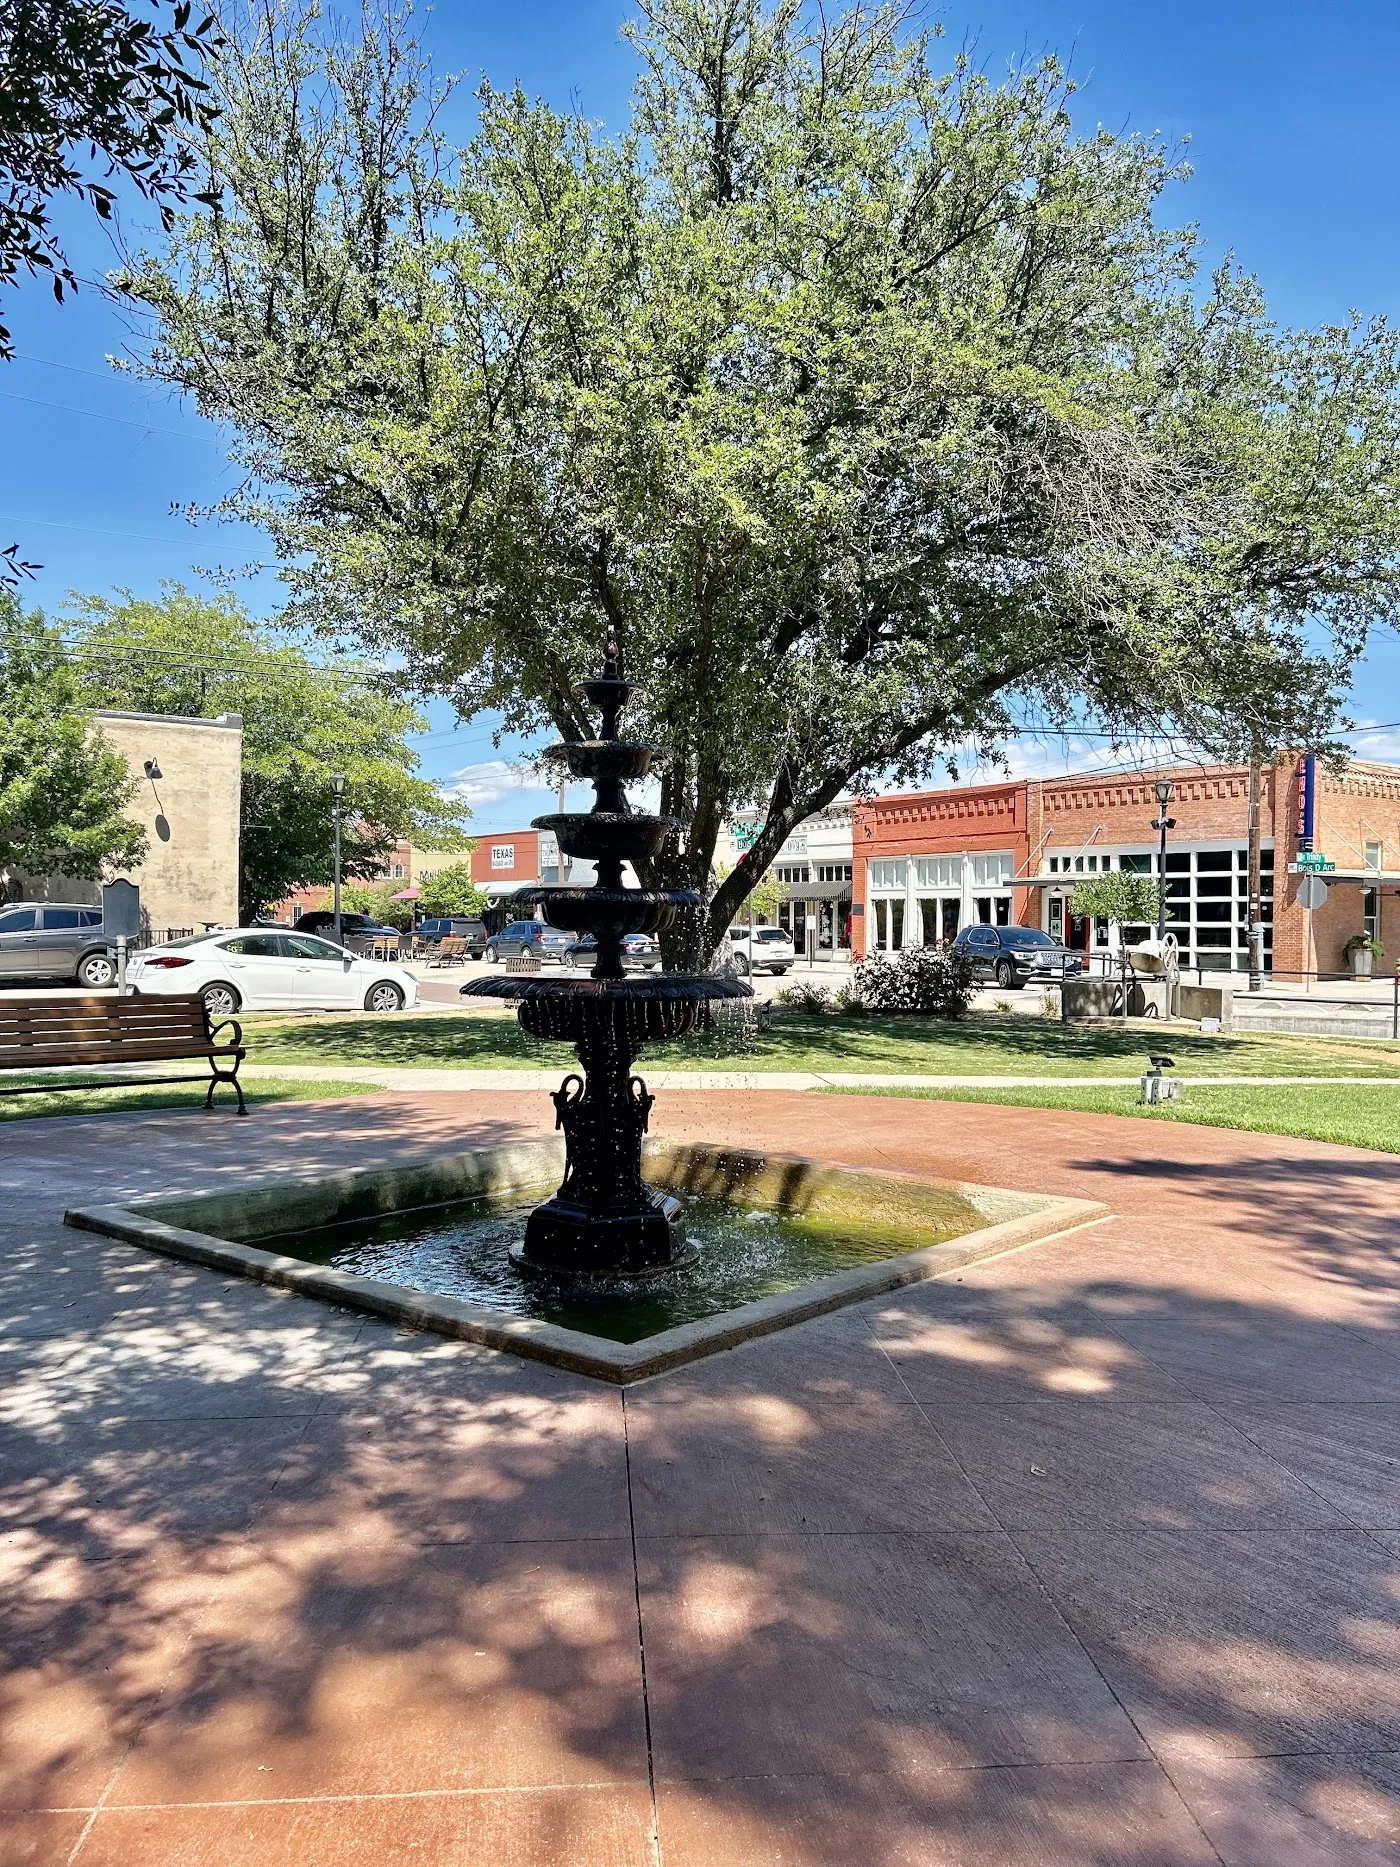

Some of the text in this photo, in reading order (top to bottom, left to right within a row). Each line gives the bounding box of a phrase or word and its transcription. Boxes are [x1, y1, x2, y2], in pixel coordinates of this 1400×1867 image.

[493, 848, 513, 859] TEXAS
[1298, 863, 1313, 872] Bois
[1323, 863, 1335, 872] Arc
